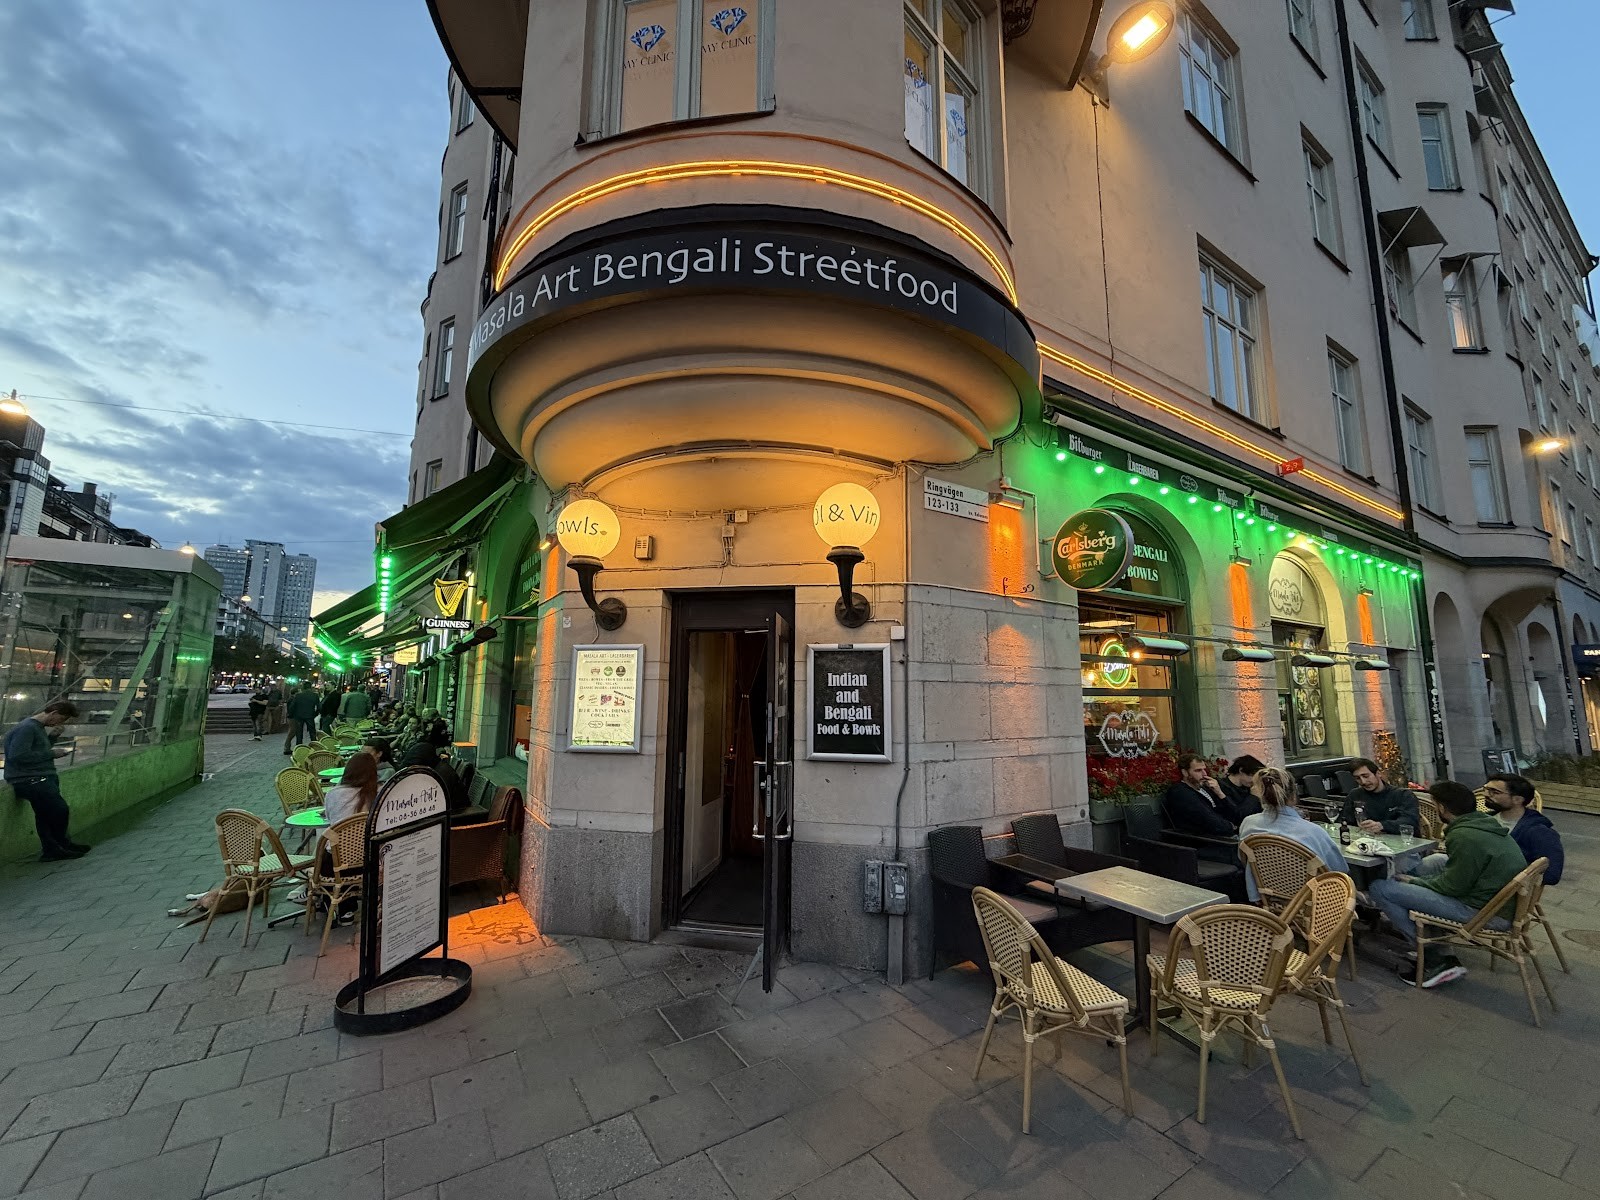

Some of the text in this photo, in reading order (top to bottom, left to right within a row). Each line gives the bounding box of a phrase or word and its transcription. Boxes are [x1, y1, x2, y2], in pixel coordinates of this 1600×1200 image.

[721, 34, 756, 50] CLINIC
[640, 51, 674, 66] CLINIC
[471, 237, 958, 351] Masala Art Bengali Streetfood
[1068, 434, 1103, 460] Bitburger
[927, 480, 964, 499] Ringvägen
[927, 497, 959, 512] 123-133
[829, 503, 845, 522] &
[850, 504, 878, 526] Vin
[1057, 532, 1116, 559] Carlsberg
[1133, 544, 1168, 563] BENGALI
[1068, 560, 1105, 571] DENMARK
[1127, 565, 1159, 582] BOWLS
[426, 618, 470, 629] GUINNESS
[827, 672, 868, 687] Indian
[836, 689, 860, 703] and
[824, 705, 872, 722] Bengali
[817, 723, 881, 736] Food & Bowls
[383, 793, 418, 813] Masala
[385, 816, 398, 825] Tel:
